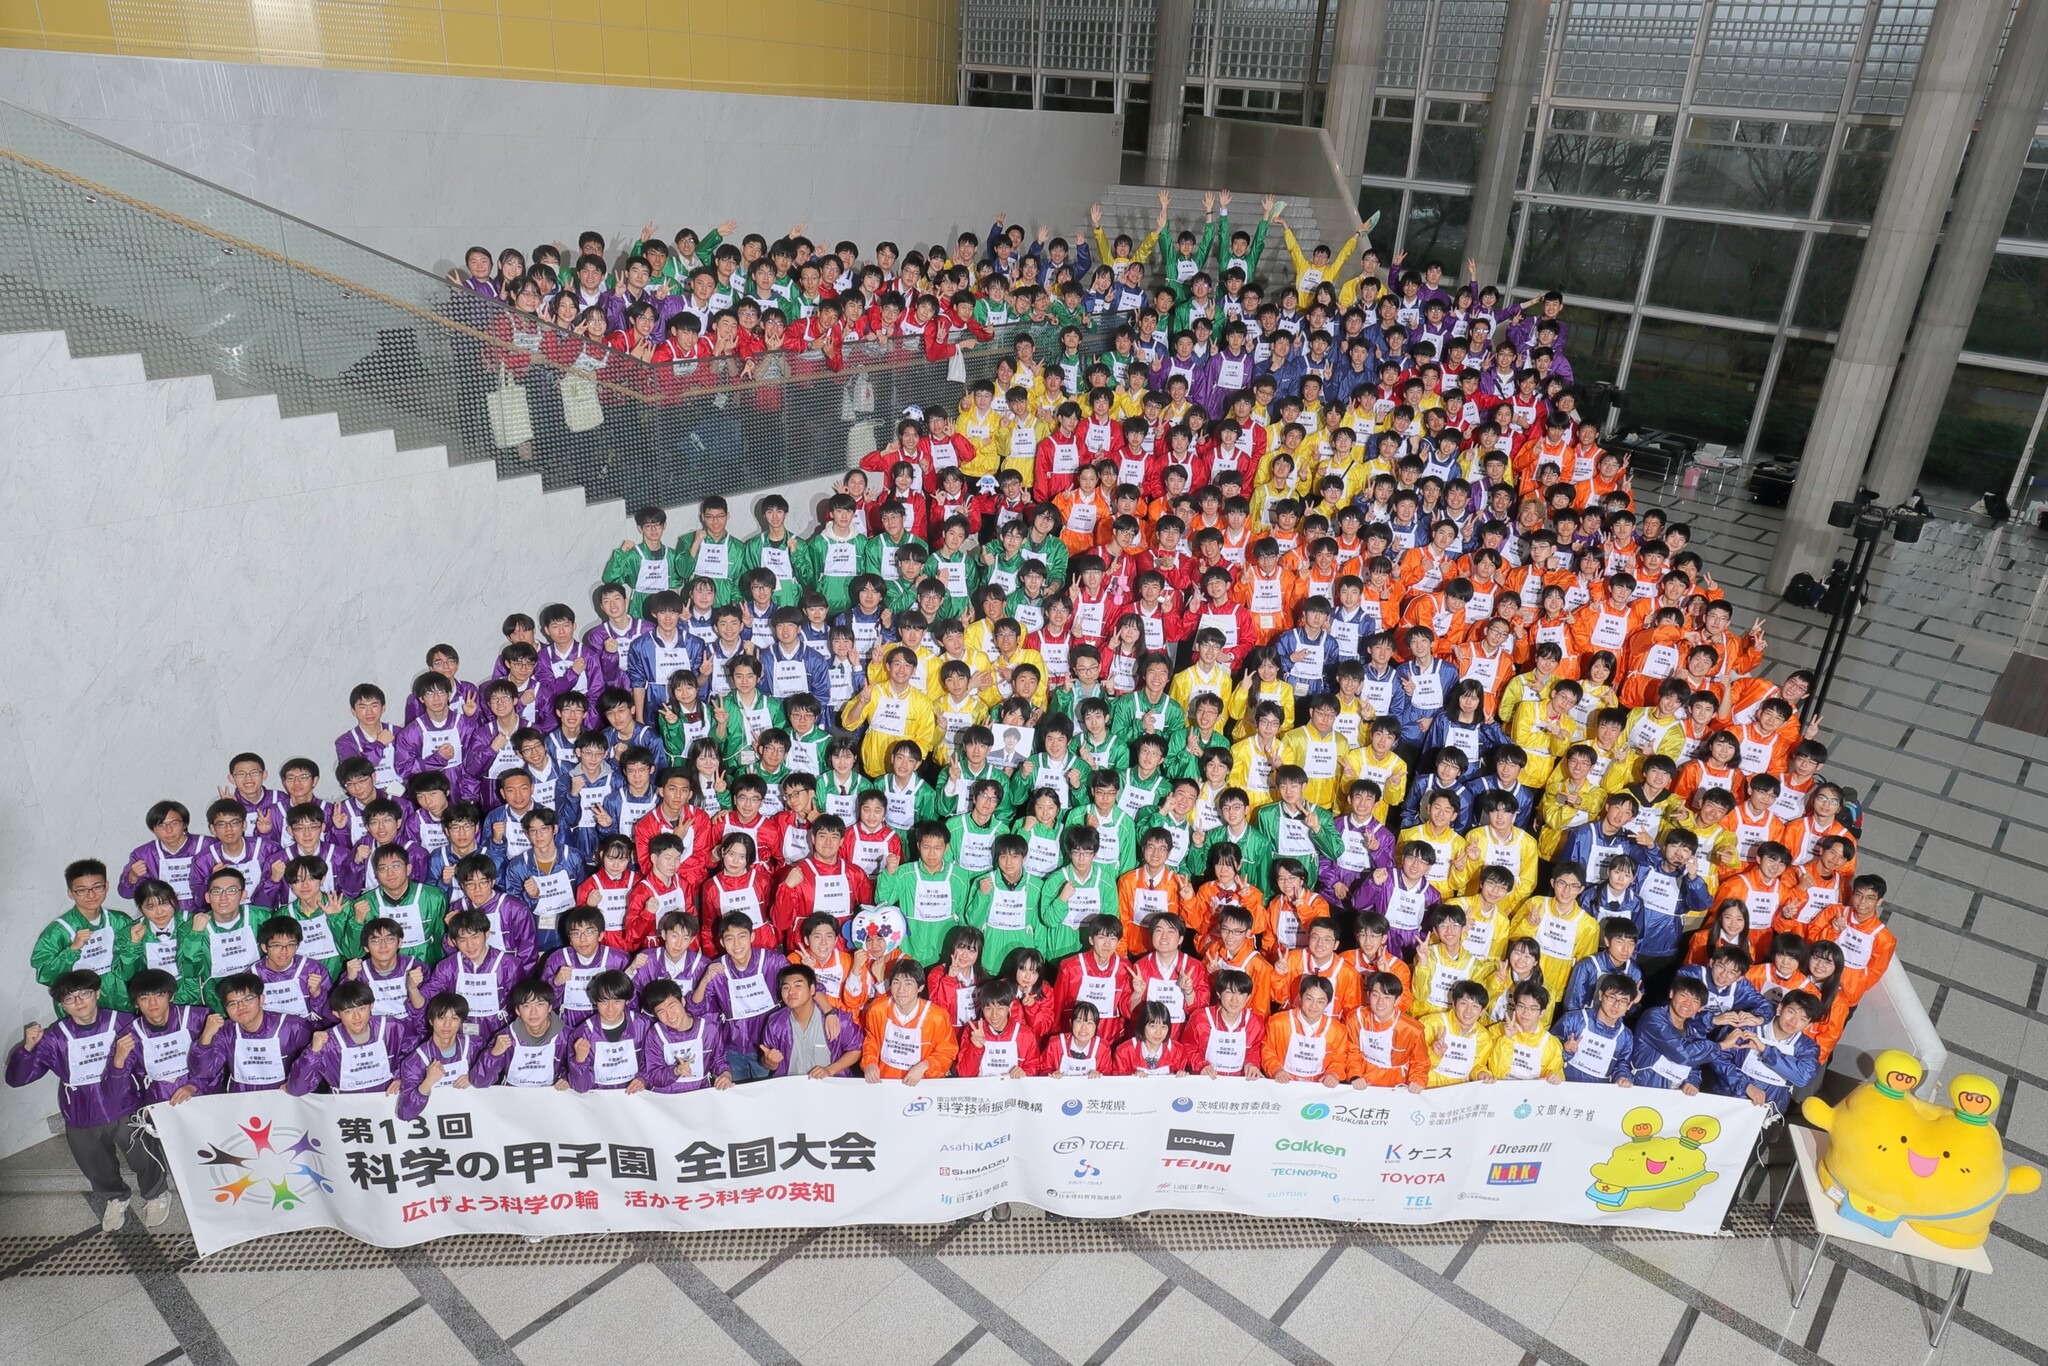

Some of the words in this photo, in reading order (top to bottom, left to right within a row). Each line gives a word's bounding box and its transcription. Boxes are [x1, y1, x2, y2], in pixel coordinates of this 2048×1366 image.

[907, 1102, 927, 1112] JST
[937, 1098, 1043, 1115] 科学技術振興機構
[1086, 1100, 1126, 1111] 茨城県
[1197, 1101, 1281, 1112] 茨城県教育委員会
[1334, 1105, 1391, 1120] つくば市
[1429, 1104, 1489, 1119] 高等学校文化連盟
[1332, 1115, 1369, 1125] TSUKUBA
[1428, 1111, 1495, 1126] 全国自然科学専門部
[1535, 1105, 1596, 1122] 文部科学省
[338, 1112, 473, 1145] 第13回
[940, 1134, 1011, 1152] AsahiKASEI
[1089, 1140, 1126, 1150] TOEFL
[1174, 1137, 1226, 1148] UCHIDA
[1275, 1138, 1347, 1157] Gakken
[1408, 1147, 1452, 1161] ケニス
[349, 1141, 657, 1194] 科学の甲子園
[675, 1131, 877, 1184] 全国大会
[951, 1156, 1010, 1175] SHIMADZU
[1161, 1159, 1232, 1173] TEIJIN
[1270, 1168, 1338, 1180] TECHNOPRO
[1380, 1173, 1446, 1185] TOYOTA
[402, 1190, 599, 1223] 広げよう科学の輪
[624, 1183, 835, 1211] 活かそう科学の英知
[1406, 1196, 1432, 1206] TEL
